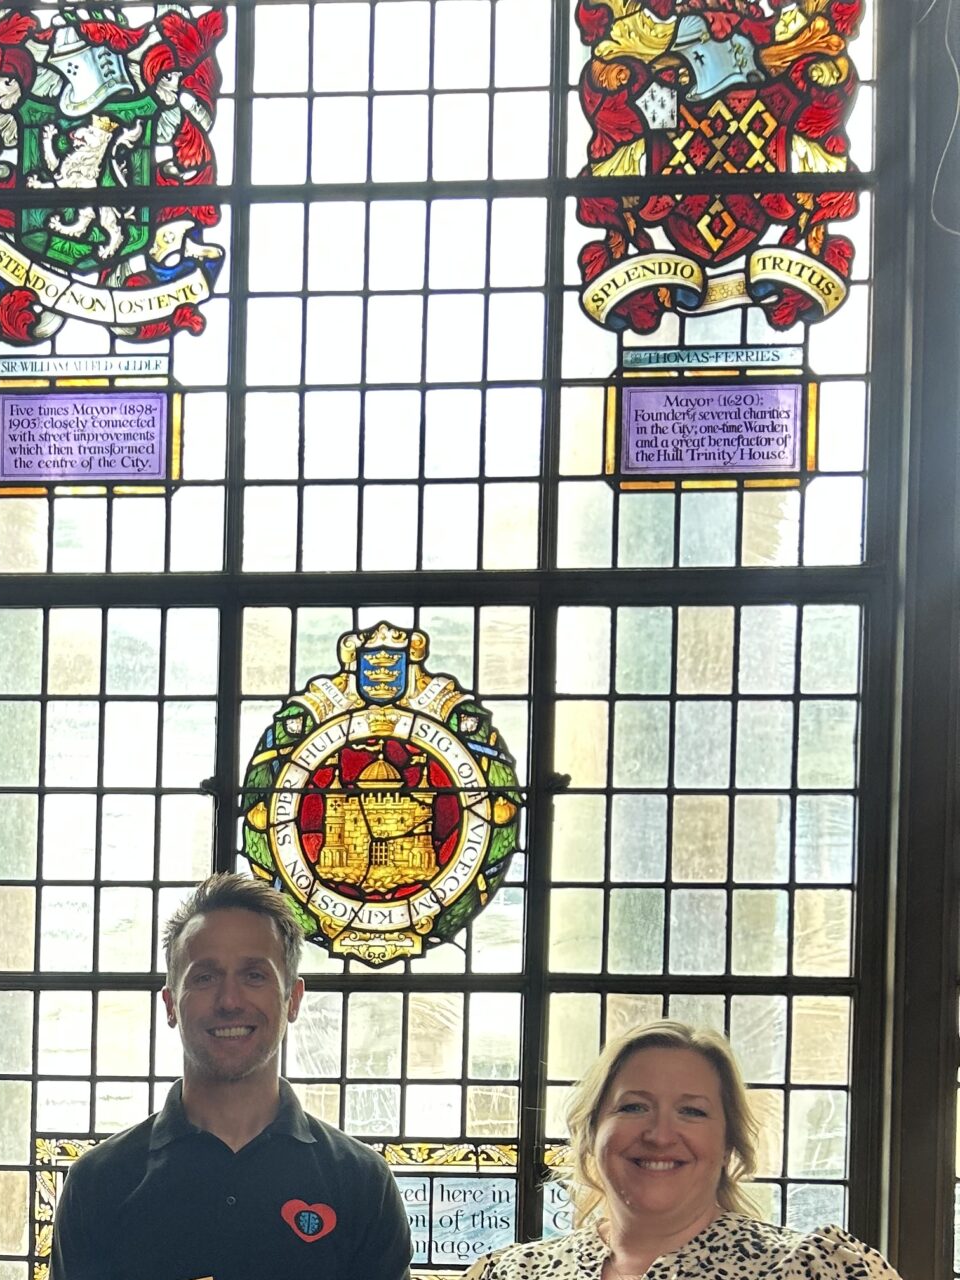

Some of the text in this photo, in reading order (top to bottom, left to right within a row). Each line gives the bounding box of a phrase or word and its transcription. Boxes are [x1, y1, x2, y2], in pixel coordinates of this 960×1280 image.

[592, 260, 695, 310] SPLENDIO
[66, 293, 108, 313] NON
[118, 280, 205, 314] OSTENTO
[663, 395, 713, 409] Mayor
[10, 404, 34, 416] Five
[38, 404, 68, 416] times
[72, 403, 116, 419] Mayor
[635, 409, 688, 421] Founder
[699, 408, 740, 419] several
[743, 407, 791, 419] charities
[92, 417, 155, 428] connected
[636, 423, 646, 434] in
[651, 423, 668, 434] the
[744, 421, 788, 432] Warden
[8, 430, 155, 445] with street improvements
[636, 434, 791, 450] and a great benefactor of
[8, 443, 155, 457] which then transformed
[635, 450, 655, 462] the
[657, 449, 682, 461] Hull
[686, 449, 737, 465] Trinity
[14, 457, 151, 472] the centre of the City.
[415, 724, 452, 752] SIG
[440, 1183, 510, 1203] here in
[439, 1210, 510, 1232] of this
